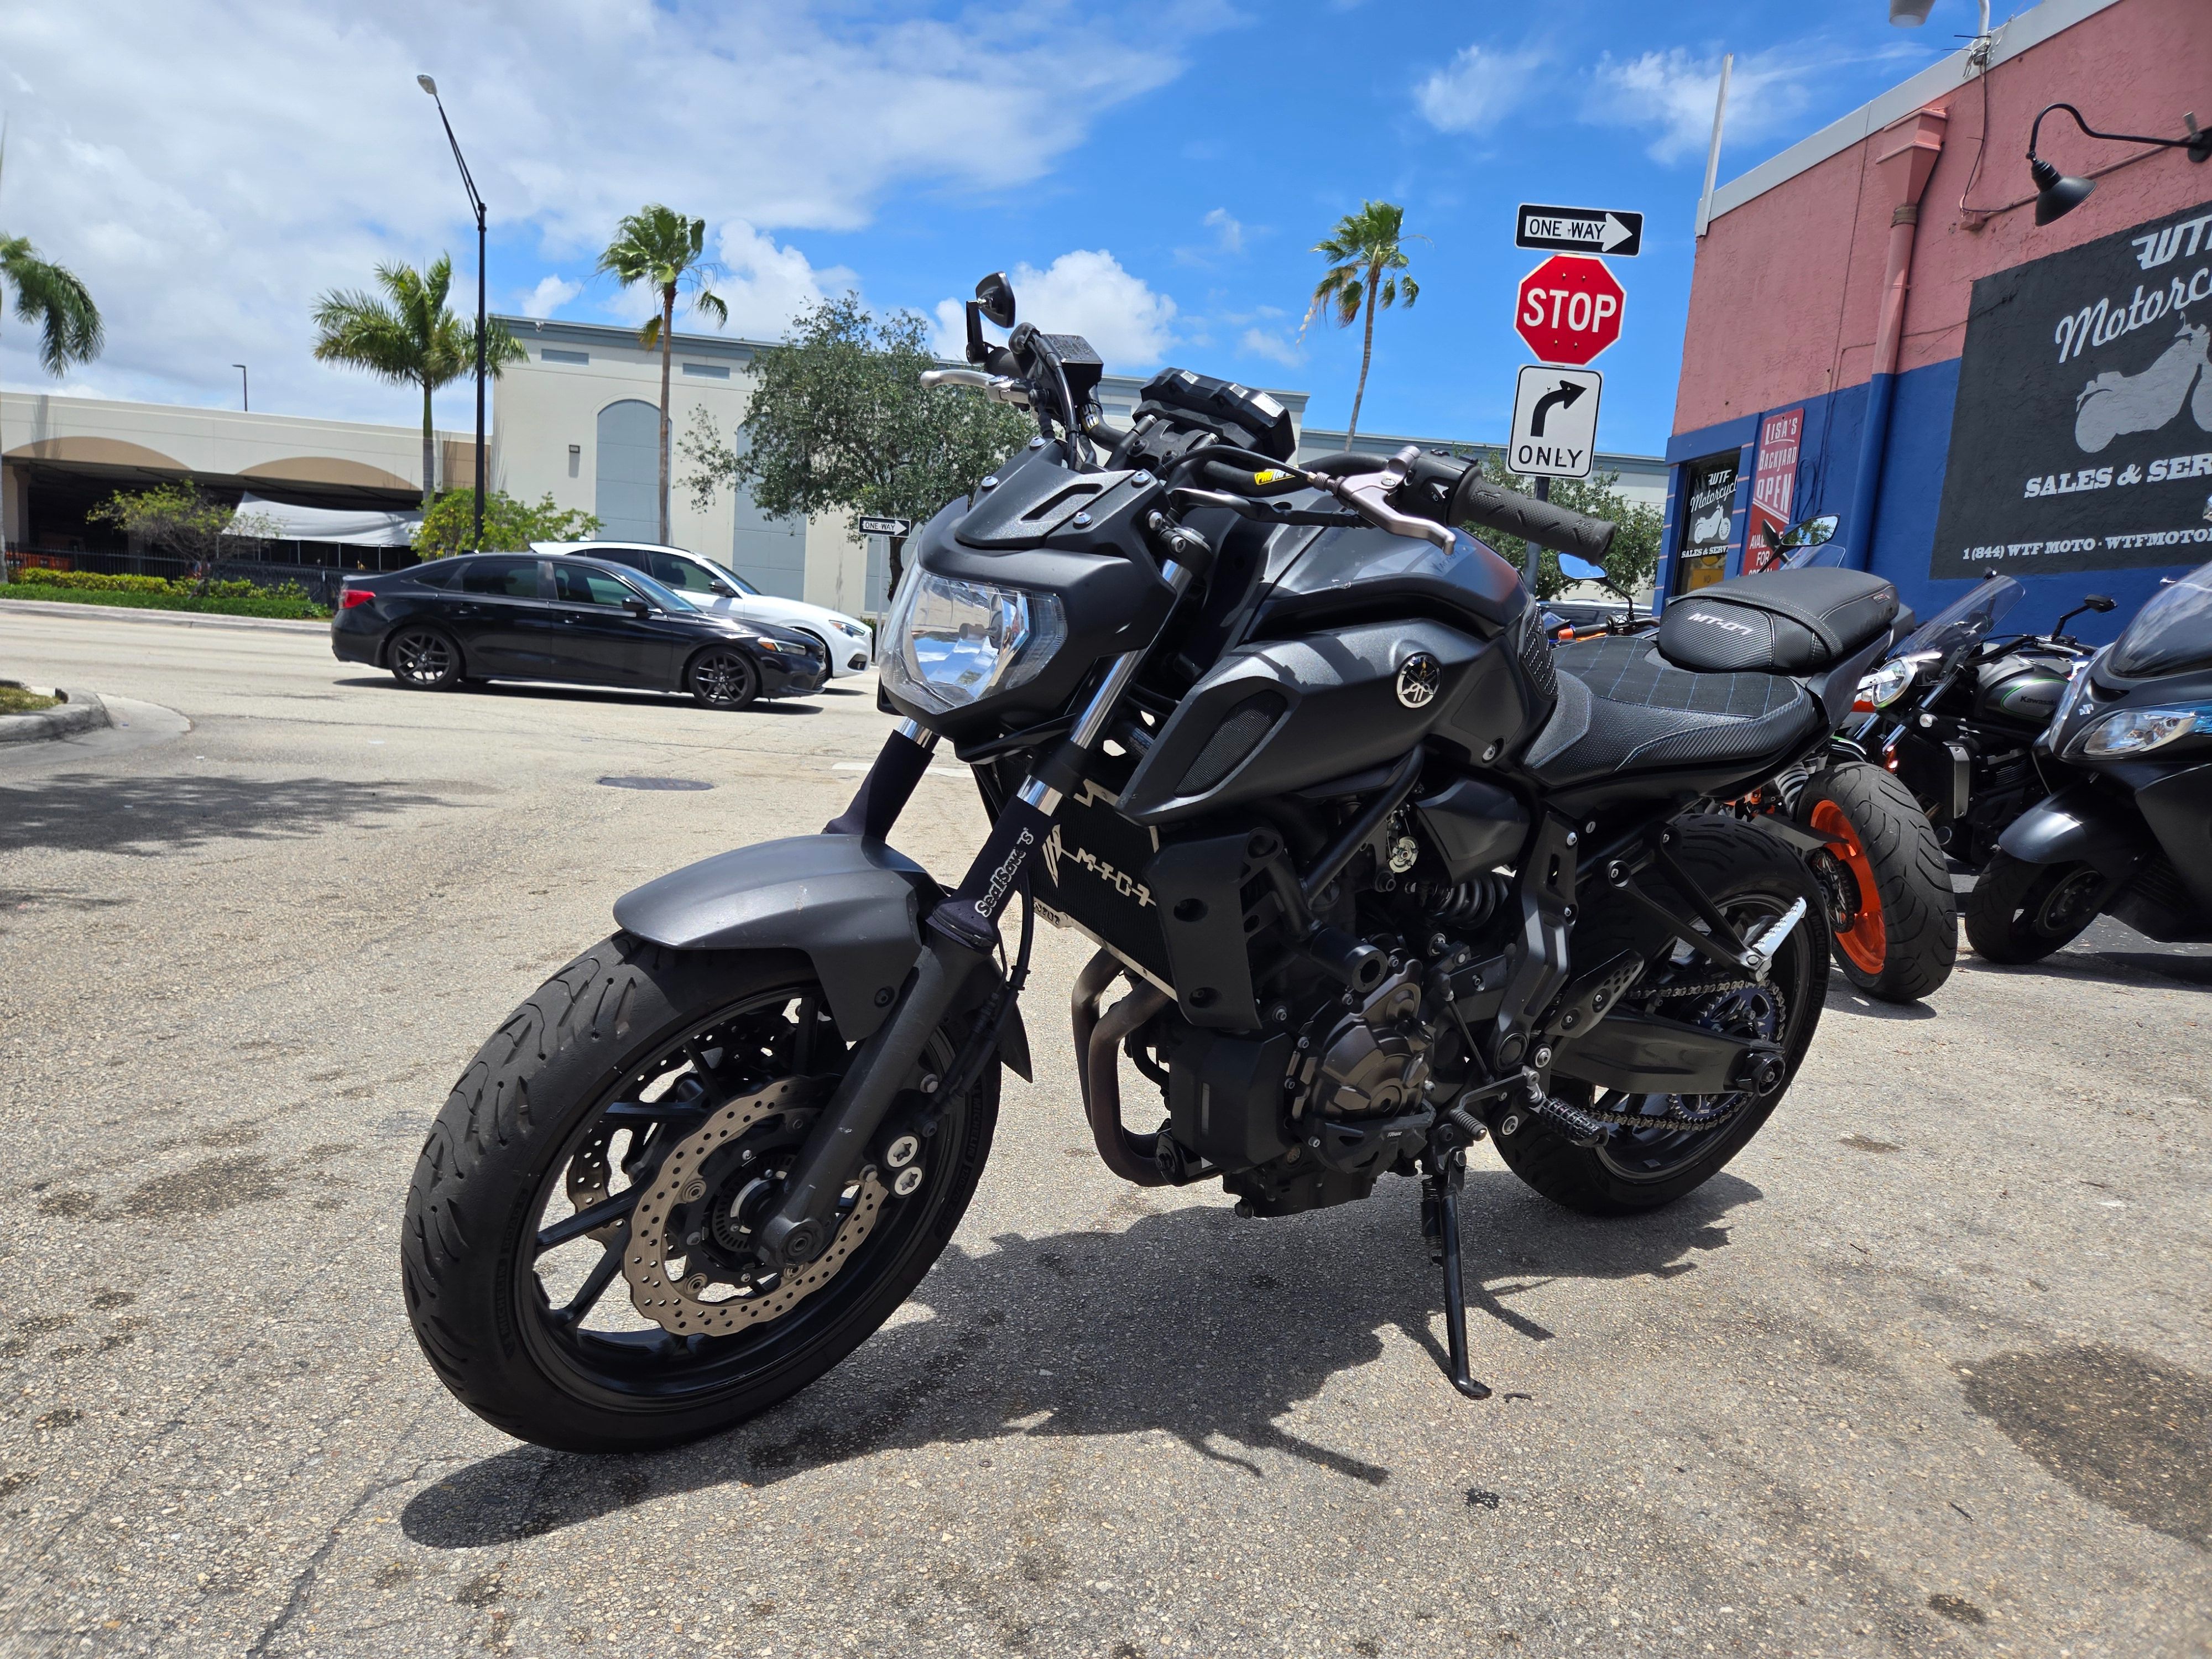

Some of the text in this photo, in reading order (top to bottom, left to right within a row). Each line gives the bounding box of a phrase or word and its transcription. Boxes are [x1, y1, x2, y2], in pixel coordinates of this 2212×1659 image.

[1530, 219, 1605, 240] ONE WAY
[1524, 288, 1616, 332] STOP
[2055, 268, 2212, 363] Motorc
[1765, 418, 1798, 445] LISA'S
[1519, 445, 1583, 468] ONLY
[1708, 469, 1732, 486] WTF
[2025, 453, 2212, 498] SALES & SER
[1757, 473, 1792, 514] OPEN
[1681, 547, 1702, 558] SALES
[1703, 547, 1708, 555] &
[1756, 551, 1770, 566] FOR
[2007, 542, 2043, 556] WTF
[2044, 538, 2095, 554] MOTO
[1687, 612, 1753, 635] MT-07
[2020, 696, 2057, 706] Kawasaki
[1810, 915, 1825, 974] MICHELIN
[968, 1098, 982, 1157] MICHELIN
[497, 1266, 509, 1335] MICHELIN
[503, 1207, 521, 1249] ROAD
